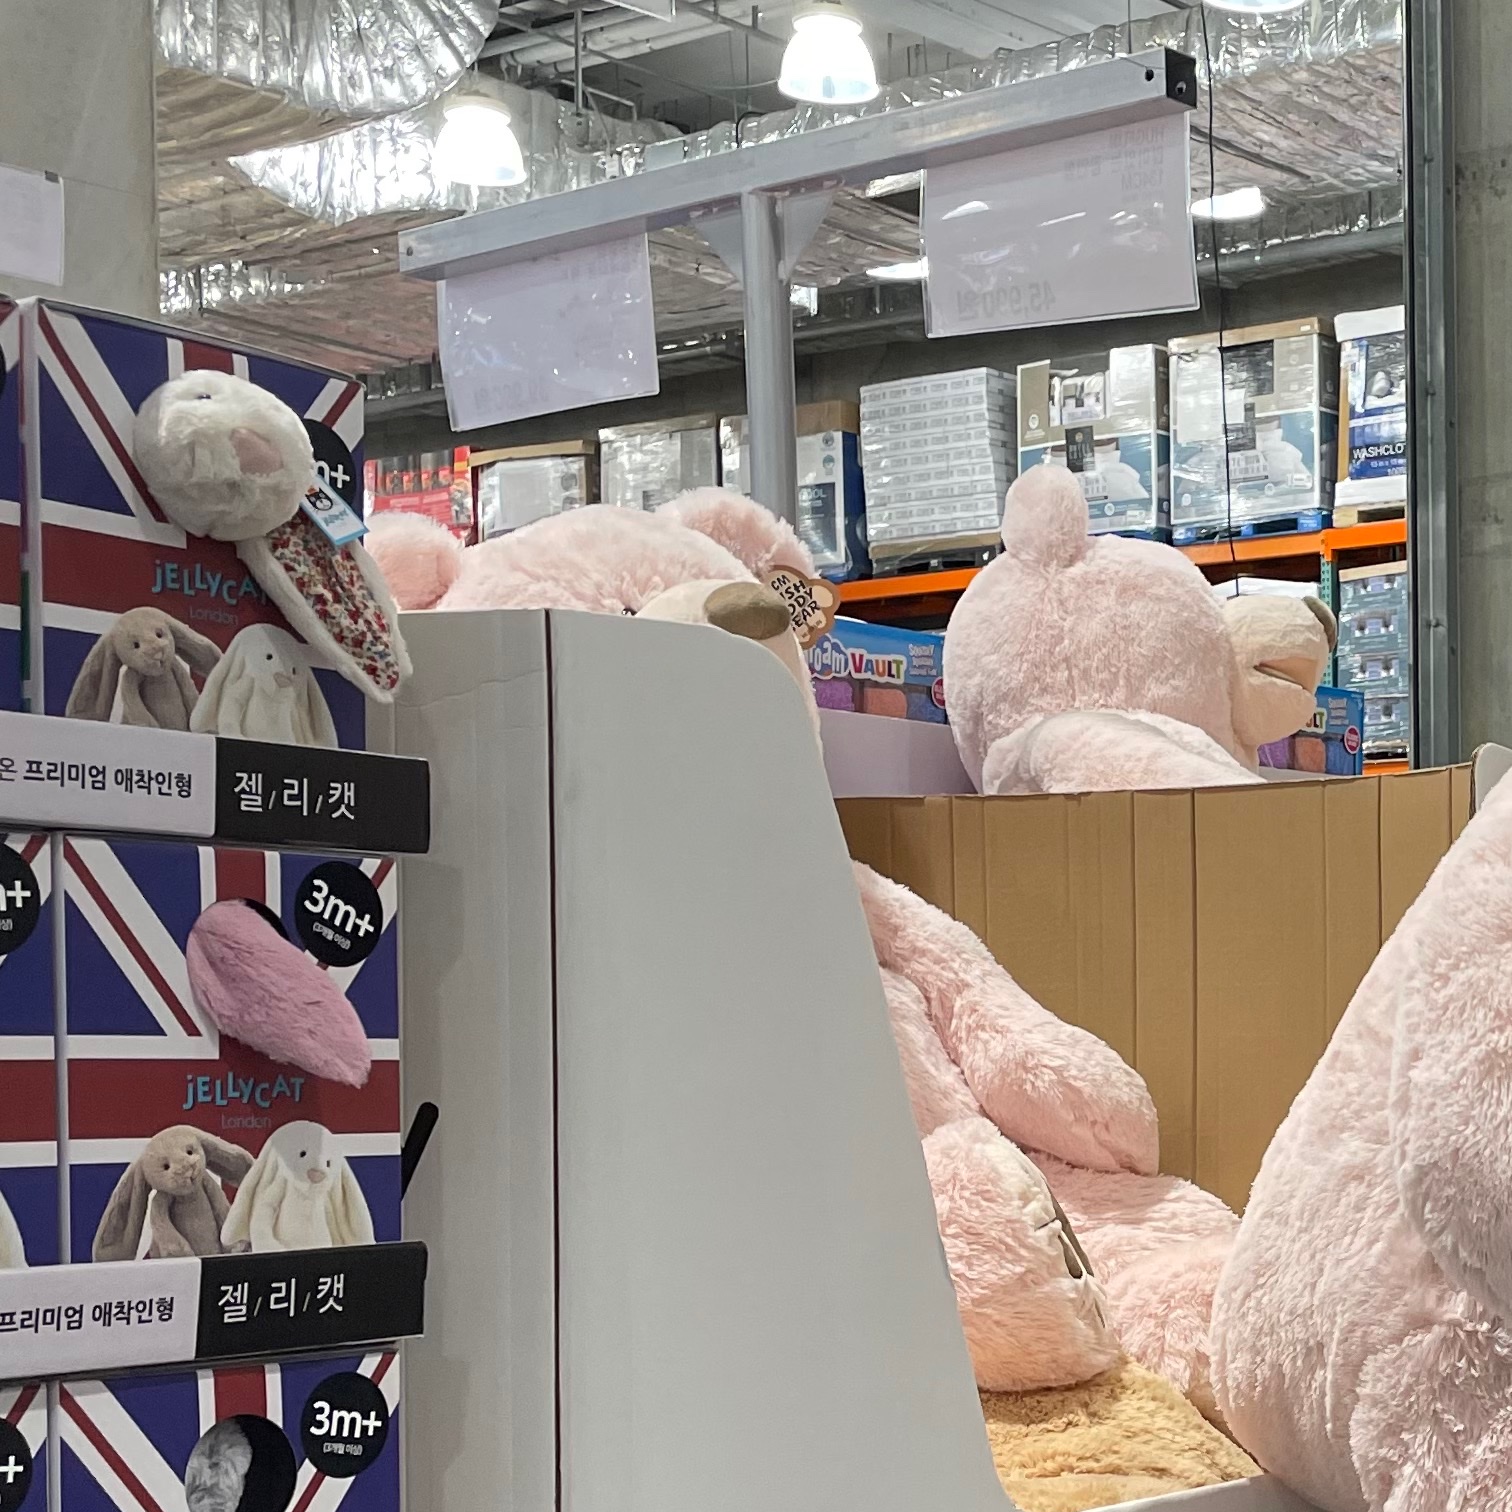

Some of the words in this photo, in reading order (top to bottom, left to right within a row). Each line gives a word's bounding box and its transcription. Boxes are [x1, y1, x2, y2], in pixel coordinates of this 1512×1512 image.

[1352, 442, 1406, 459] WASHCLO
[189, 607, 240, 626] London
[792, 600, 821, 632] EAR
[850, 651, 904, 680] VAULT
[23, 759, 107, 792] 프리미엄
[114, 767, 193, 799] 애착인형
[303, 878, 375, 938] 3m+
[221, 1113, 272, 1130] London
[0, 1305, 84, 1333] 프리미엄
[91, 1296, 175, 1328] 애착인형
[310, 1400, 382, 1438] 3m+
